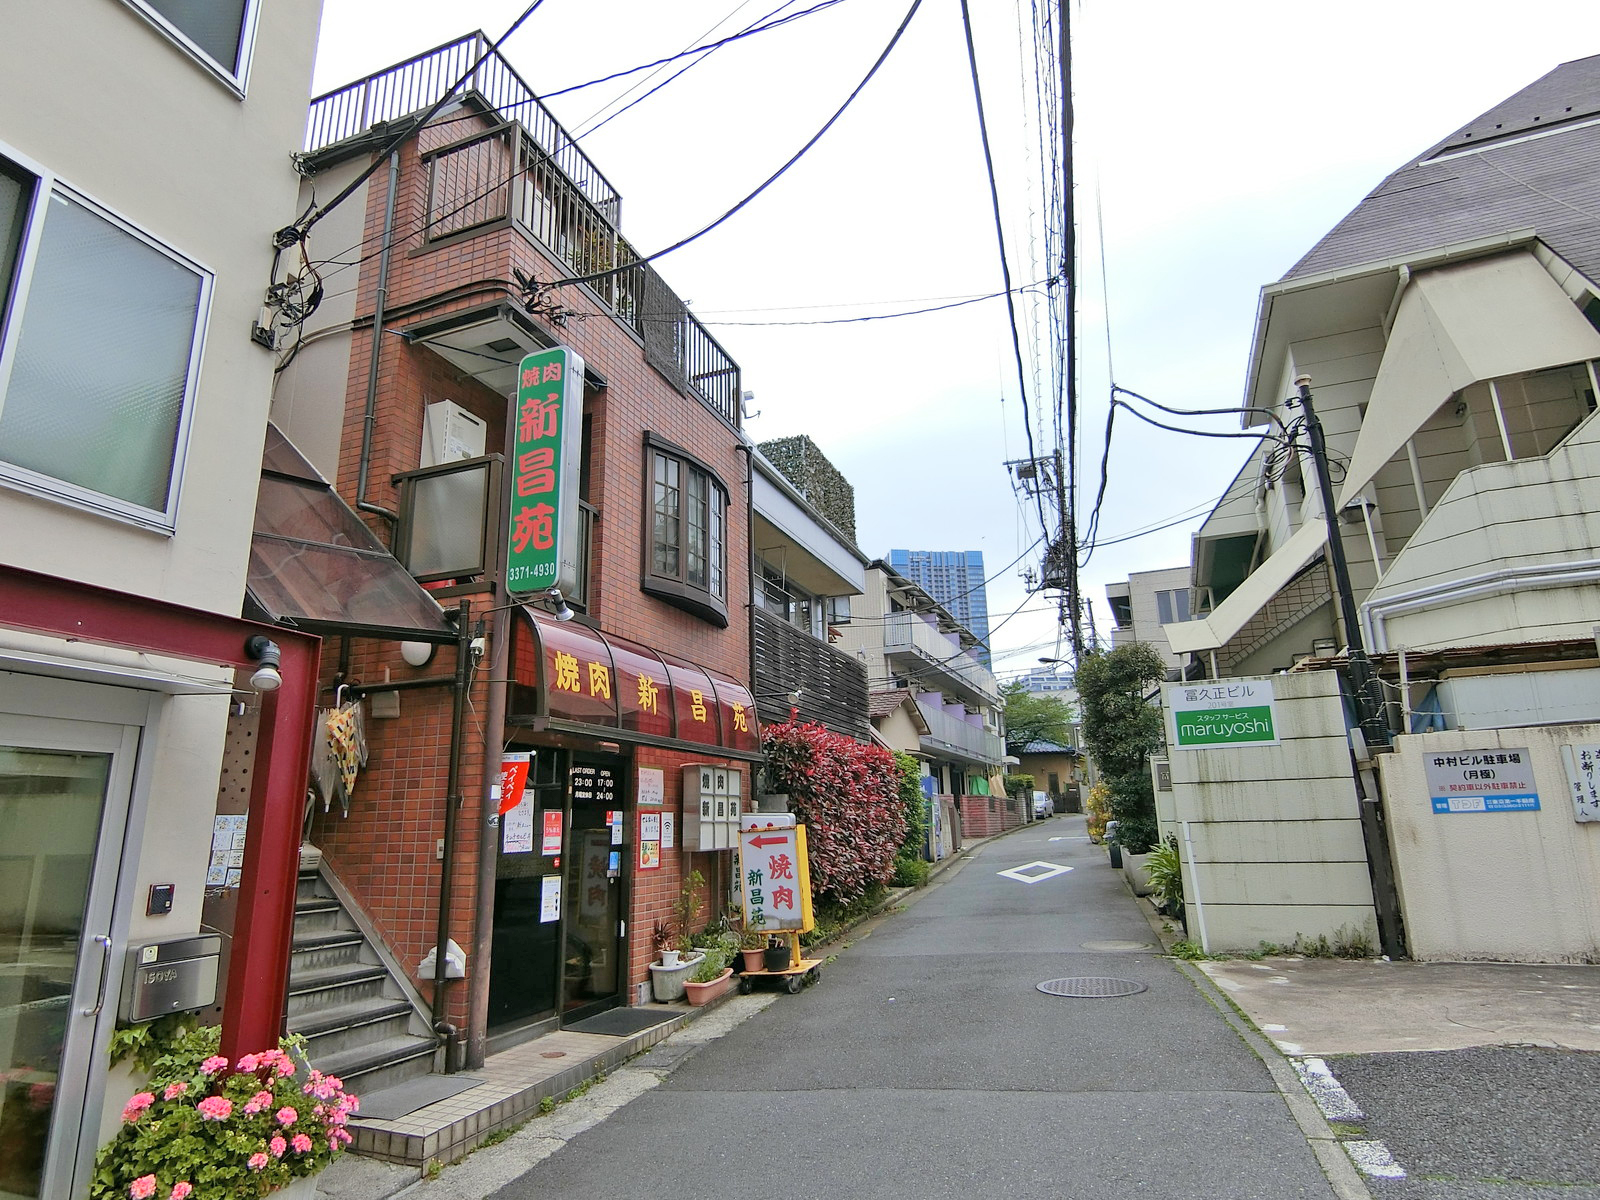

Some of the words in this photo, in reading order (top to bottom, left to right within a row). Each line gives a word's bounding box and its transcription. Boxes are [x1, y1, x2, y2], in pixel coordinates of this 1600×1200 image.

[521, 362, 562, 388] 焼肉
[512, 393, 560, 554] 新昌苑
[509, 562, 555, 581] 3371-4930
[555, 650, 611, 700] 焼肉
[637, 672, 748, 733] 新昌苑
[1181, 718, 1269, 738] maruyoshi
[1433, 753, 1521, 767] 中村ビル駐車場
[505, 765, 519, 800] ペイペイ
[574, 778, 593, 787] 23:00
[597, 779, 614, 788] 17:00
[702, 773, 724, 790] 焼肉
[1463, 769, 1496, 780] (月極)
[1581, 750, 1600, 808] お断りします
[596, 791, 614, 800] 24:00
[1449, 781, 1527, 792] 契約車以外駐車禁止
[702, 800, 737, 817] 新昌苑
[1573, 782, 1589, 816] 管理人
[769, 853, 793, 911] 焼肉
[748, 869, 766, 926] 新昌苑
